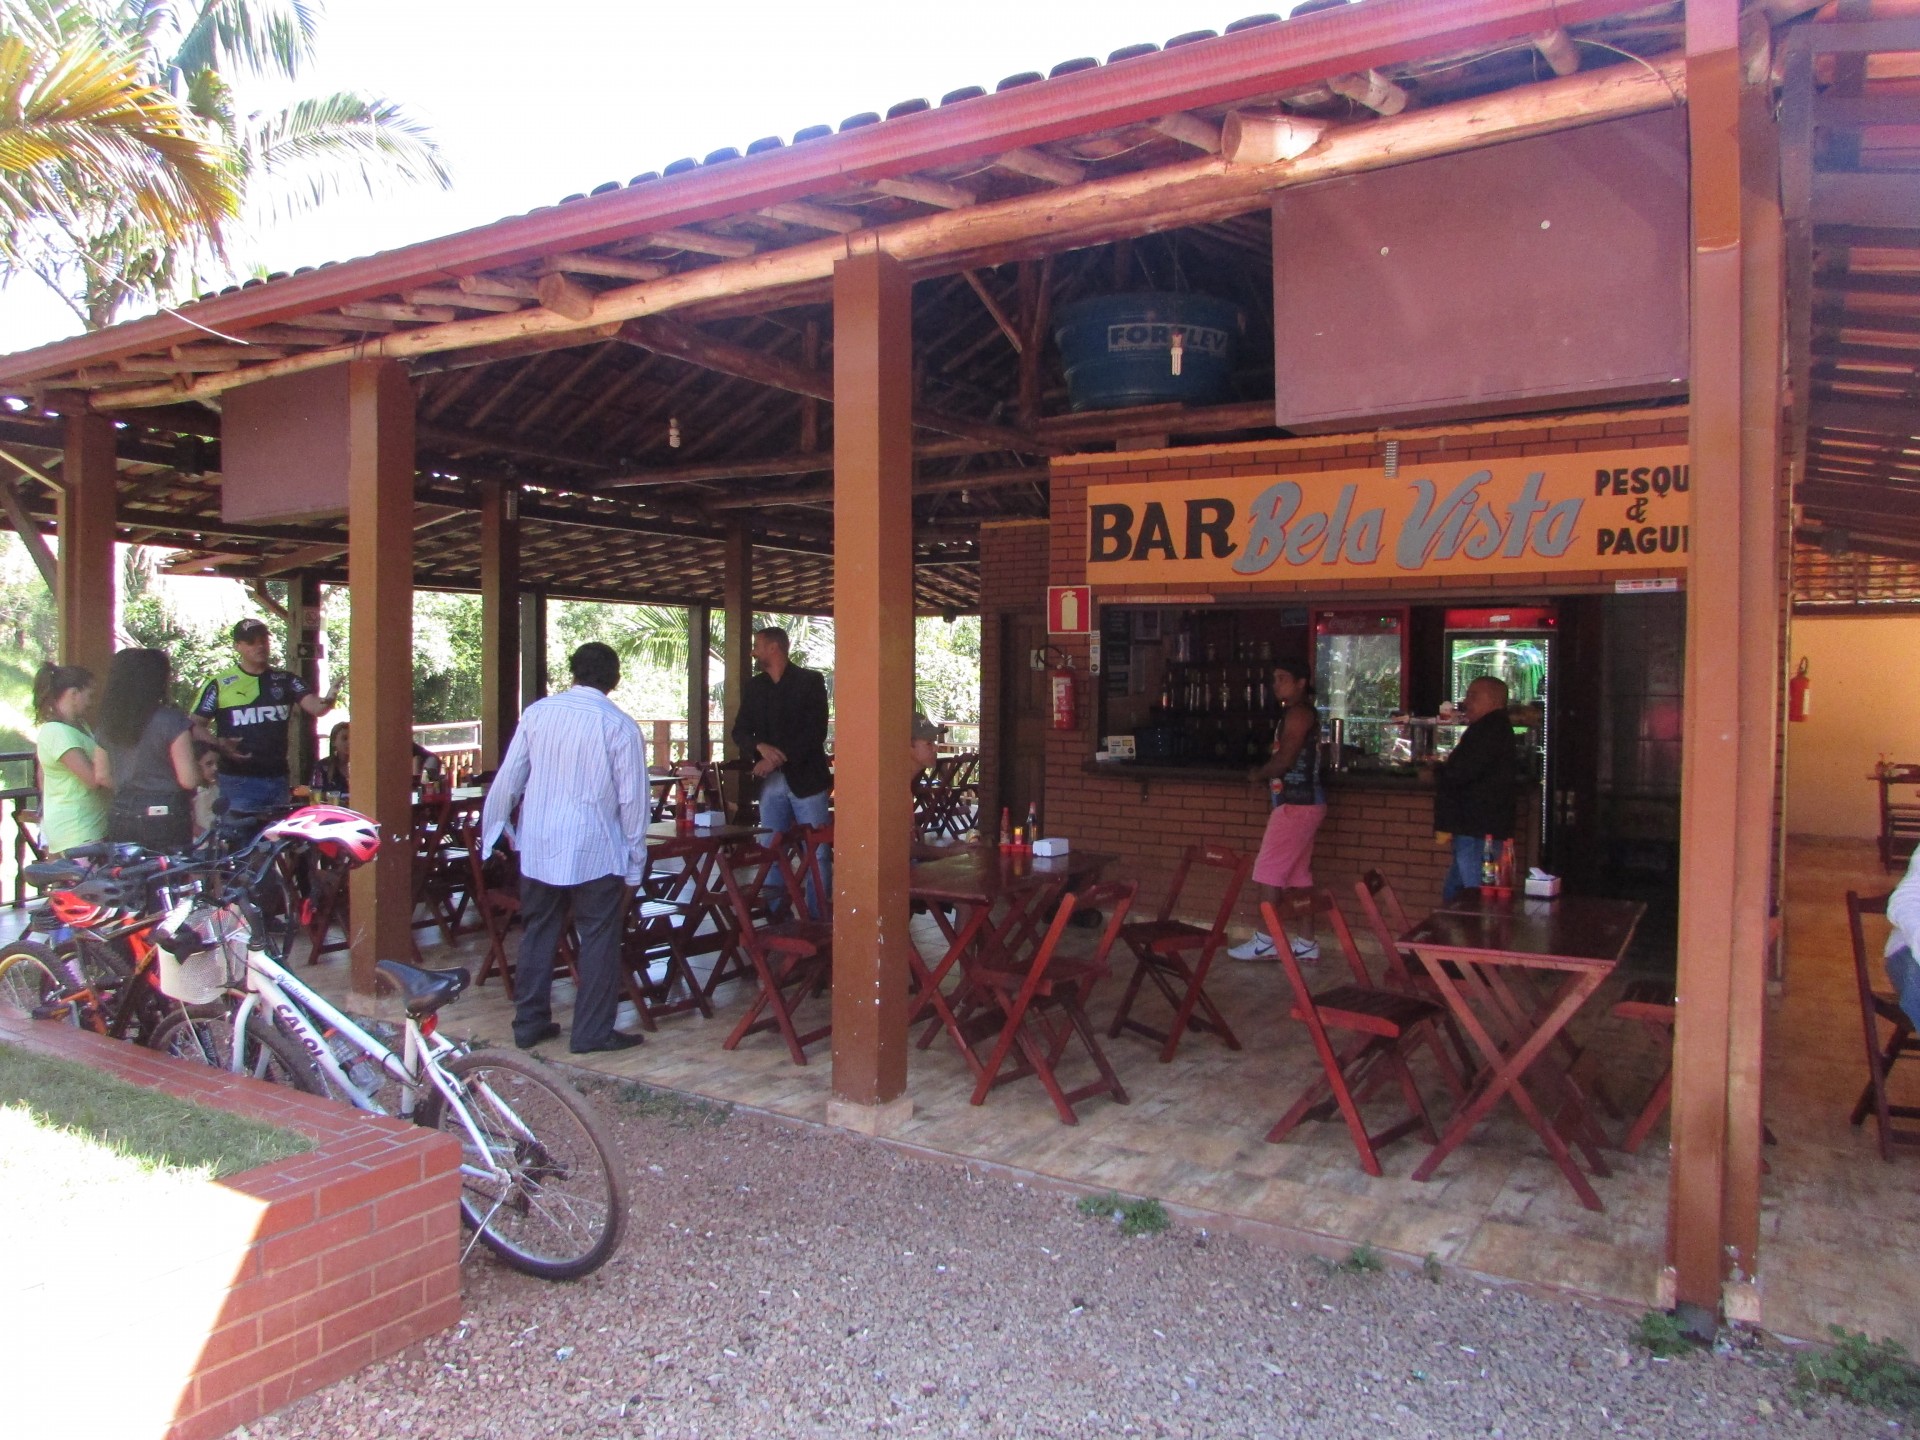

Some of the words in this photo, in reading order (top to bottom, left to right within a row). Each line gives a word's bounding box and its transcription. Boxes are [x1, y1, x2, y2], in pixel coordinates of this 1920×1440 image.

[1088, 498, 1238, 563] BAR
[1231, 481, 1385, 575] Bela
[1396, 469, 1585, 570] Vista
[1626, 497, 1648, 523] &
[232, 705, 290, 727] MRV
[276, 1004, 325, 1057] CALOI
